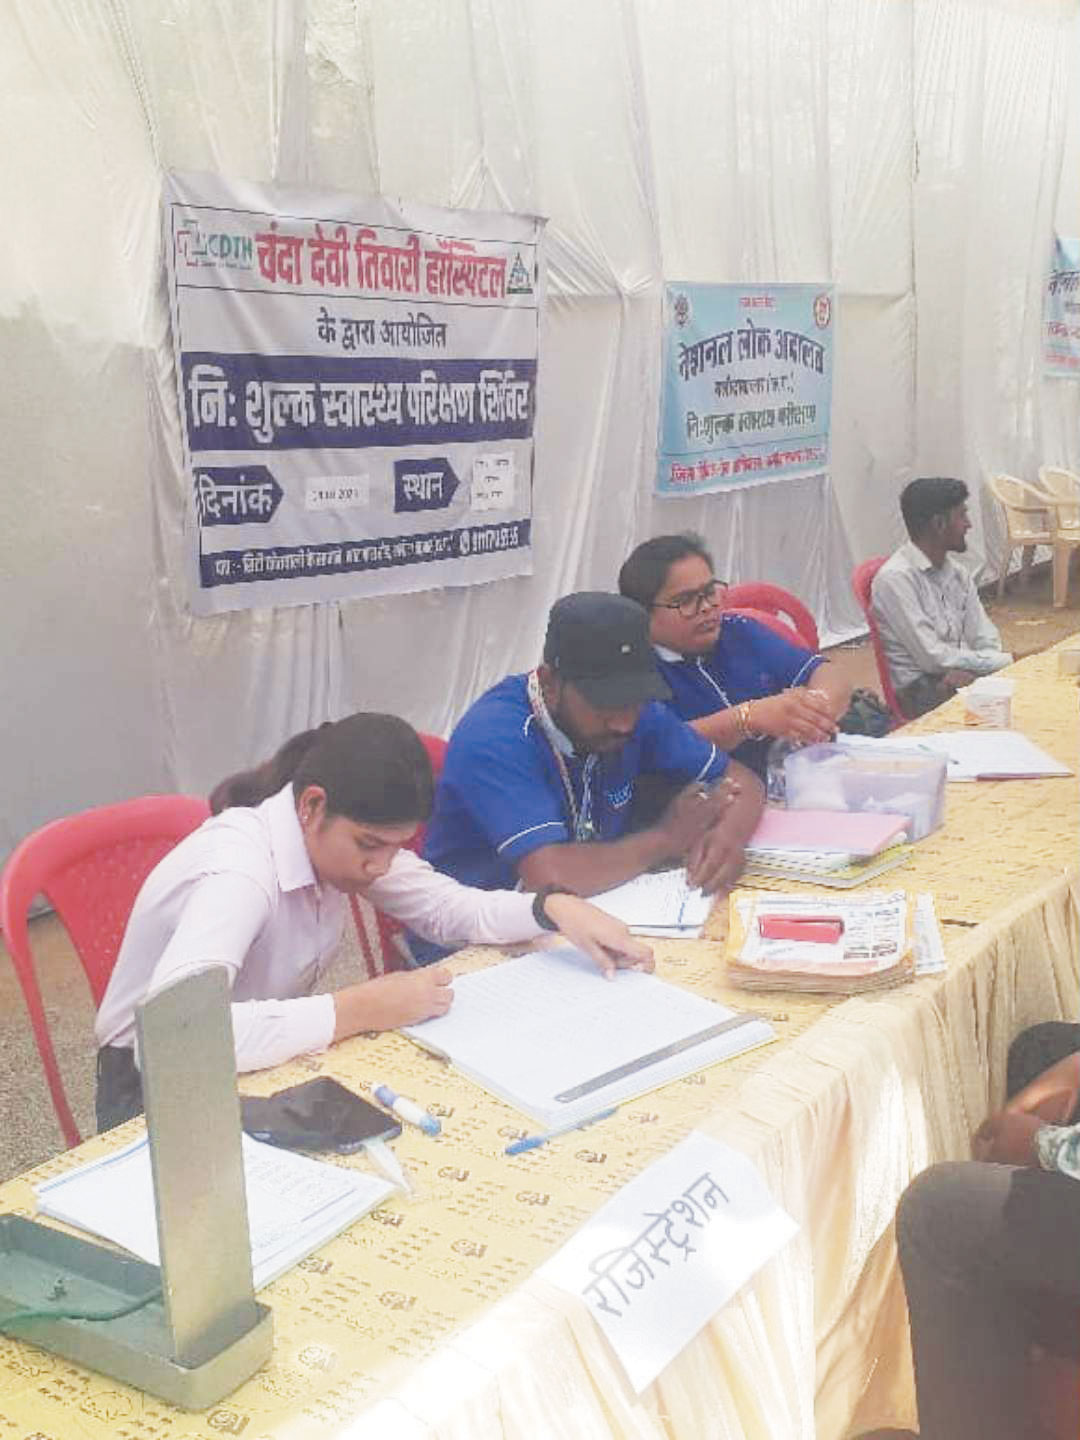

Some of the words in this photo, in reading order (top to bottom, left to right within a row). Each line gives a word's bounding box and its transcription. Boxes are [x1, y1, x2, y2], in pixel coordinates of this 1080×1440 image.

[255, 221, 305, 285] चंदा
[307, 223, 350, 289] देवी
[353, 230, 421, 295] तिवारी
[316, 307, 336, 345] के
[341, 318, 375, 351] द्वारा
[380, 313, 448, 348] आयोजित
[200, 474, 274, 517] दिनांक
[402, 471, 445, 502] स्थान
